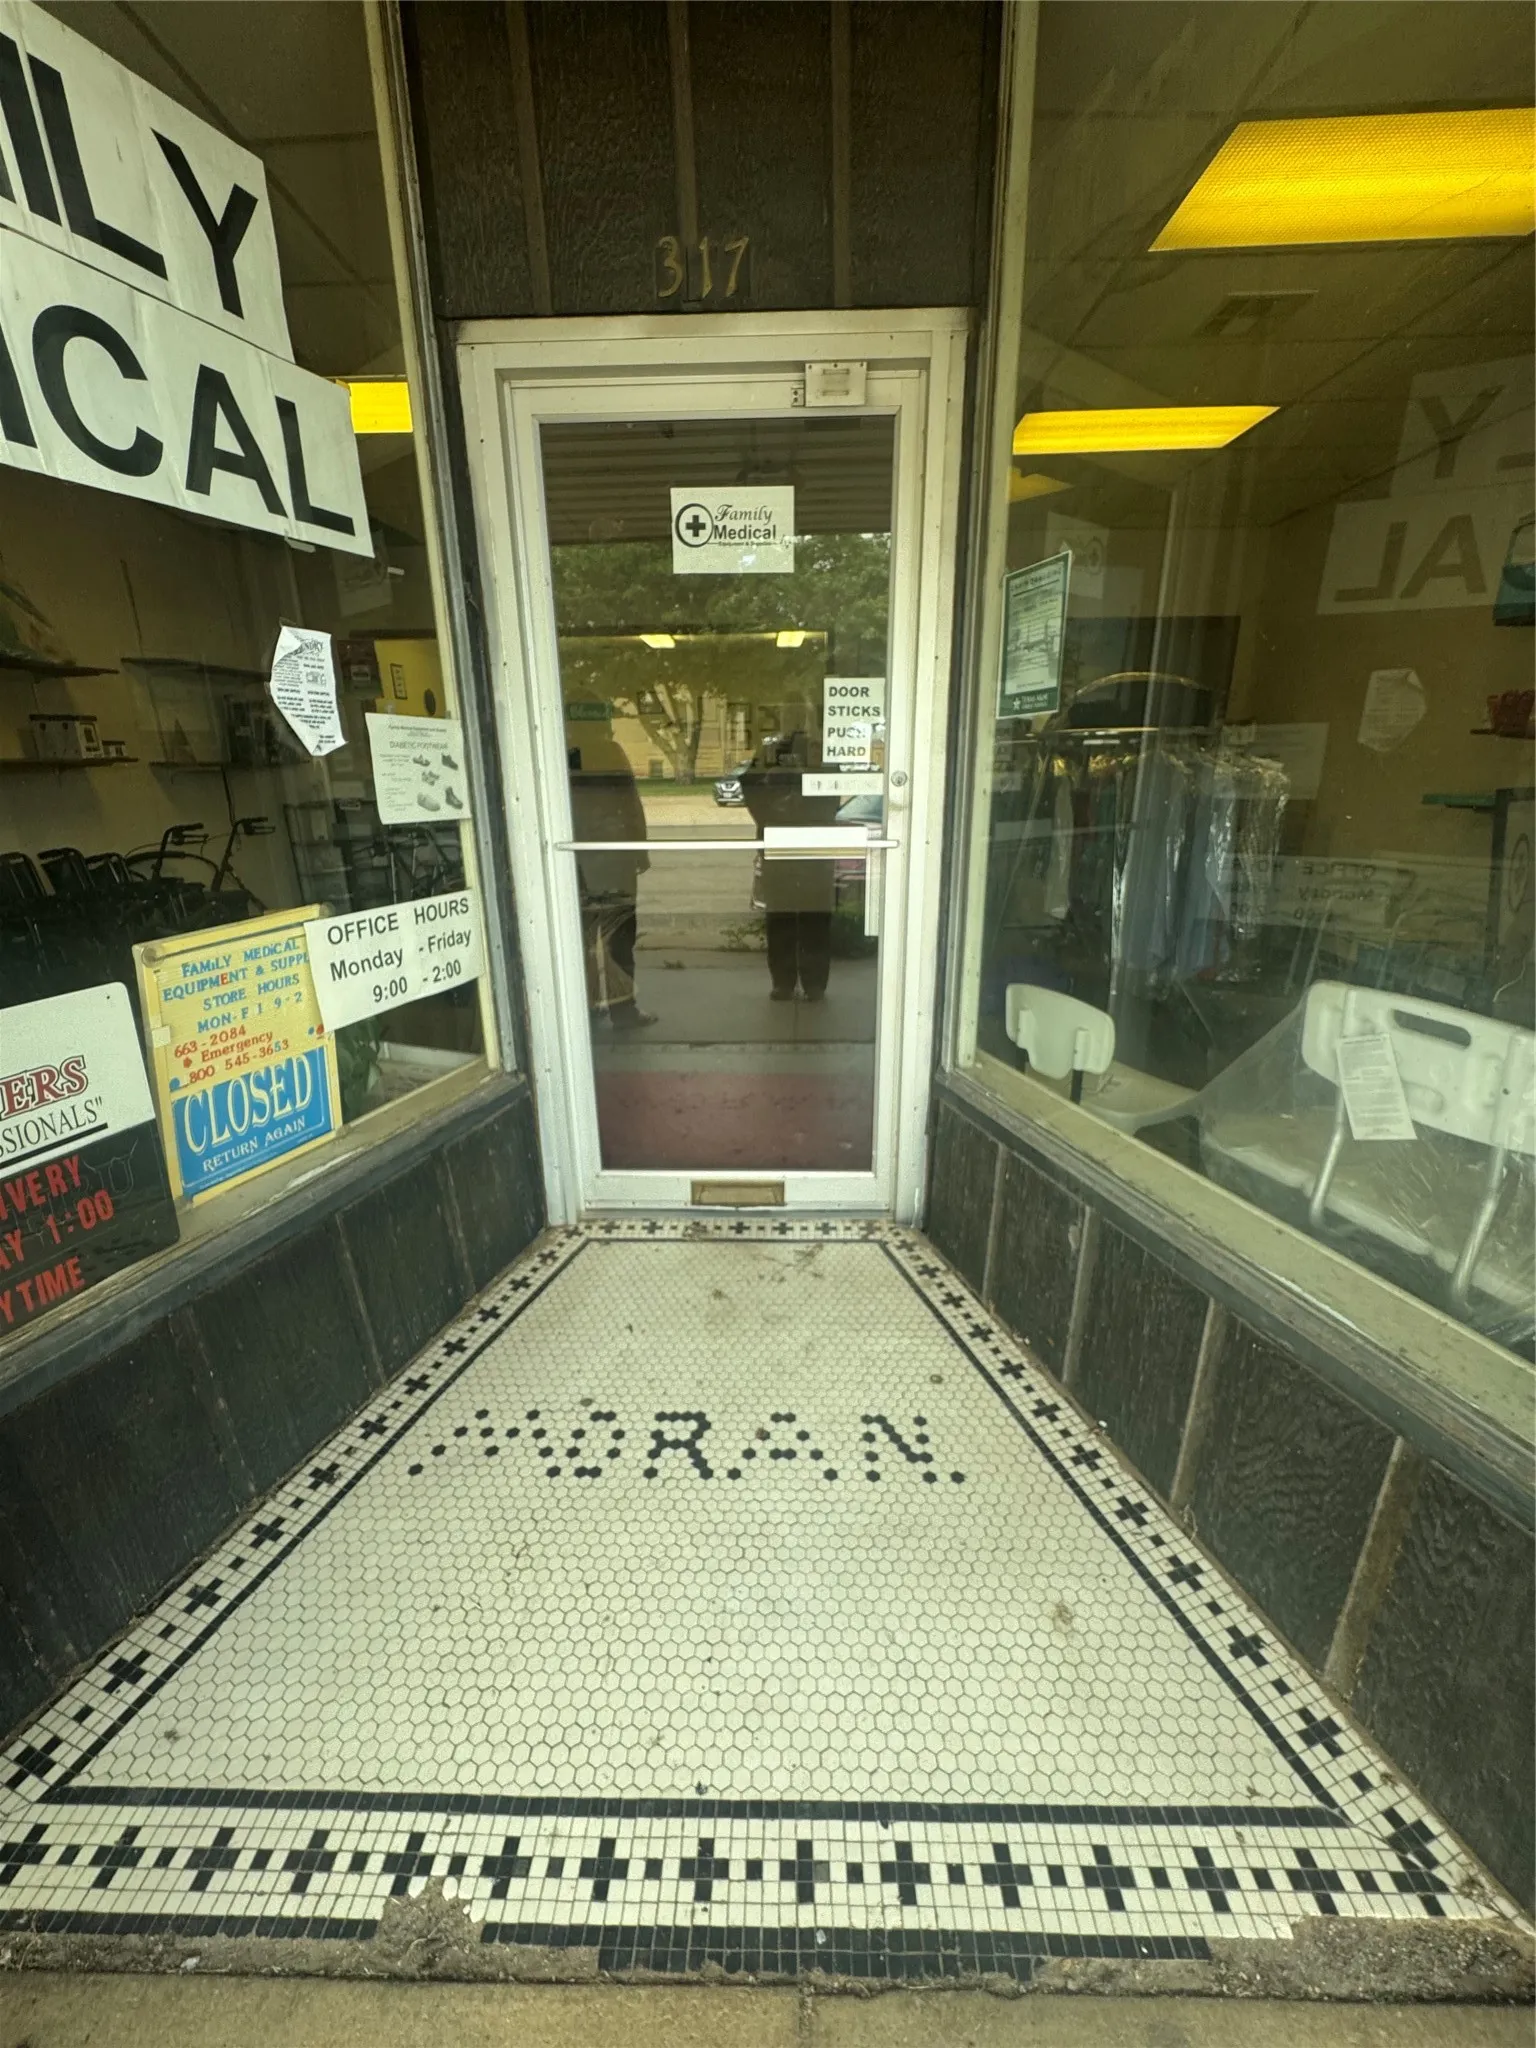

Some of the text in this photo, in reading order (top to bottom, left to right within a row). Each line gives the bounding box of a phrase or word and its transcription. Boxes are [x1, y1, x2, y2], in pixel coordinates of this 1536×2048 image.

[0, 32, 258, 320] ILY
[657, 235, 750, 299] 317
[713, 524, 777, 540] Medical
[714, 504, 773, 526] Family
[827, 705, 881, 718] STICKS
[828, 686, 870, 698] DOOR
[826, 745, 867, 757] HARD
[327, 897, 470, 945] OFFICE HOURS
[329, 947, 404, 982] Monday
[427, 929, 472, 954] Friday
[162, 967, 249, 1002] EQUIPMENT
[202, 973, 300, 1012] STORE HOURS
[372, 976, 408, 1003] 9:00
[432, 959, 462, 984] 2:00
[188, 1038, 290, 1085] 800 545-3653
[200, 1031, 274, 1063] Emergency
[184, 1054, 313, 1156] CLOSED
[202, 1136, 259, 1173] RETURN
[264, 1114, 306, 1148] AGAIN
[46, 1188, 115, 1245] 1:00
